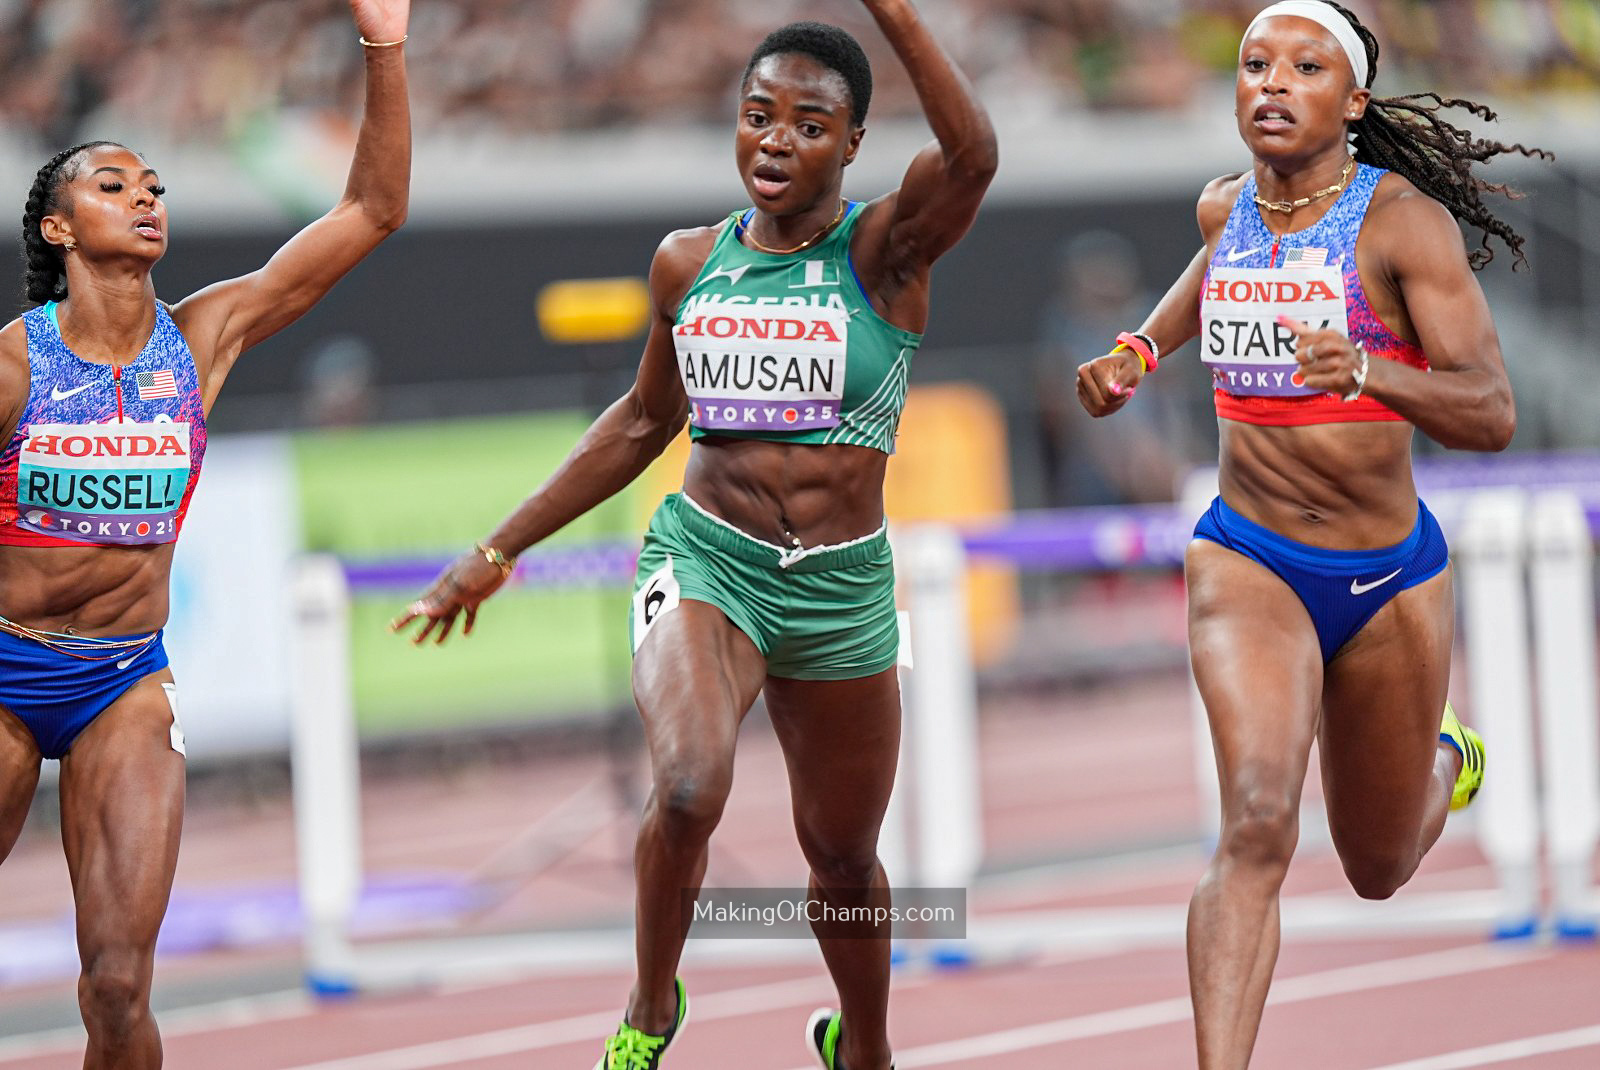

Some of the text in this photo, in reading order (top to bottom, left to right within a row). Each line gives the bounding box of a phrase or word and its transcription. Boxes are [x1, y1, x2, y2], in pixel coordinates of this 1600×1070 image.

[1205, 280, 1339, 302] HONDA
[676, 316, 841, 342] HONDA
[1208, 319, 1331, 358] STAR
[685, 352, 834, 393] AMUSAN
[24, 435, 186, 457] HONDA
[28, 470, 176, 510] RUSSELL
